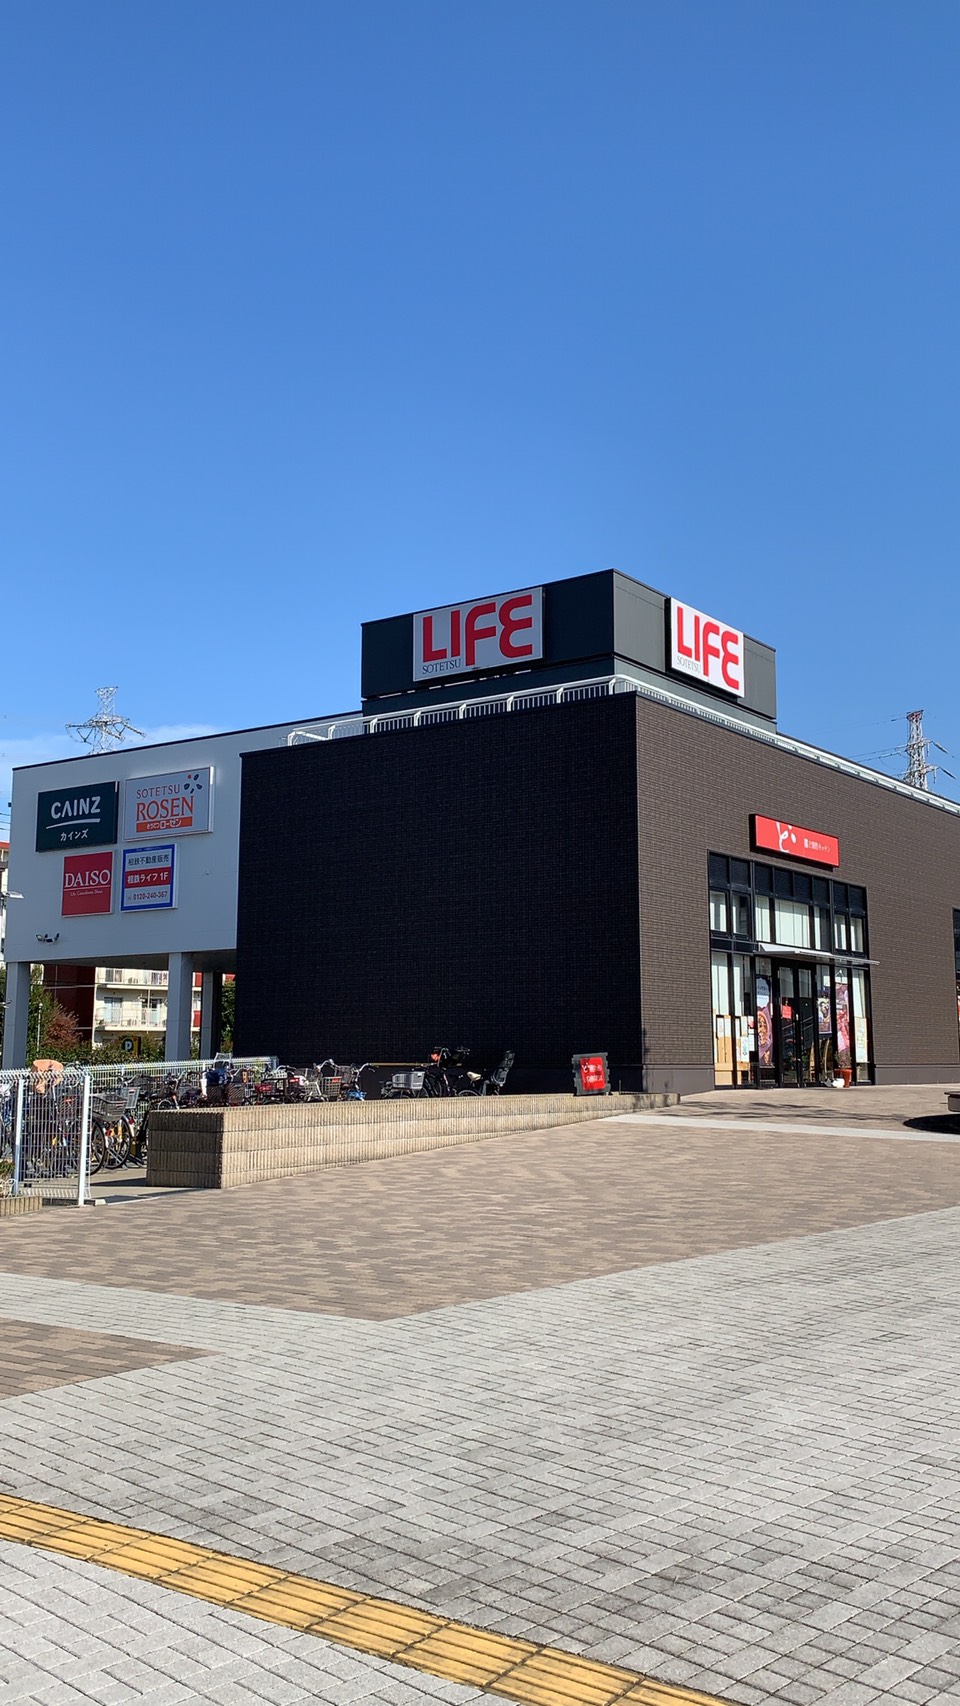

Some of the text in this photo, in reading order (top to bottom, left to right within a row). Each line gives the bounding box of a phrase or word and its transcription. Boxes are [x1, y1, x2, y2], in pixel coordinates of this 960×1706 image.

[423, 594, 533, 667] LIFE
[677, 606, 740, 690] LIFE
[422, 659, 461, 675] SOTETSU
[136, 784, 180, 799] SOTETSU
[51, 796, 101, 819] CAINZ
[136, 795, 194, 821] ROSEN
[60, 829, 89, 841] カインズ
[64, 869, 111, 888] DAISO
